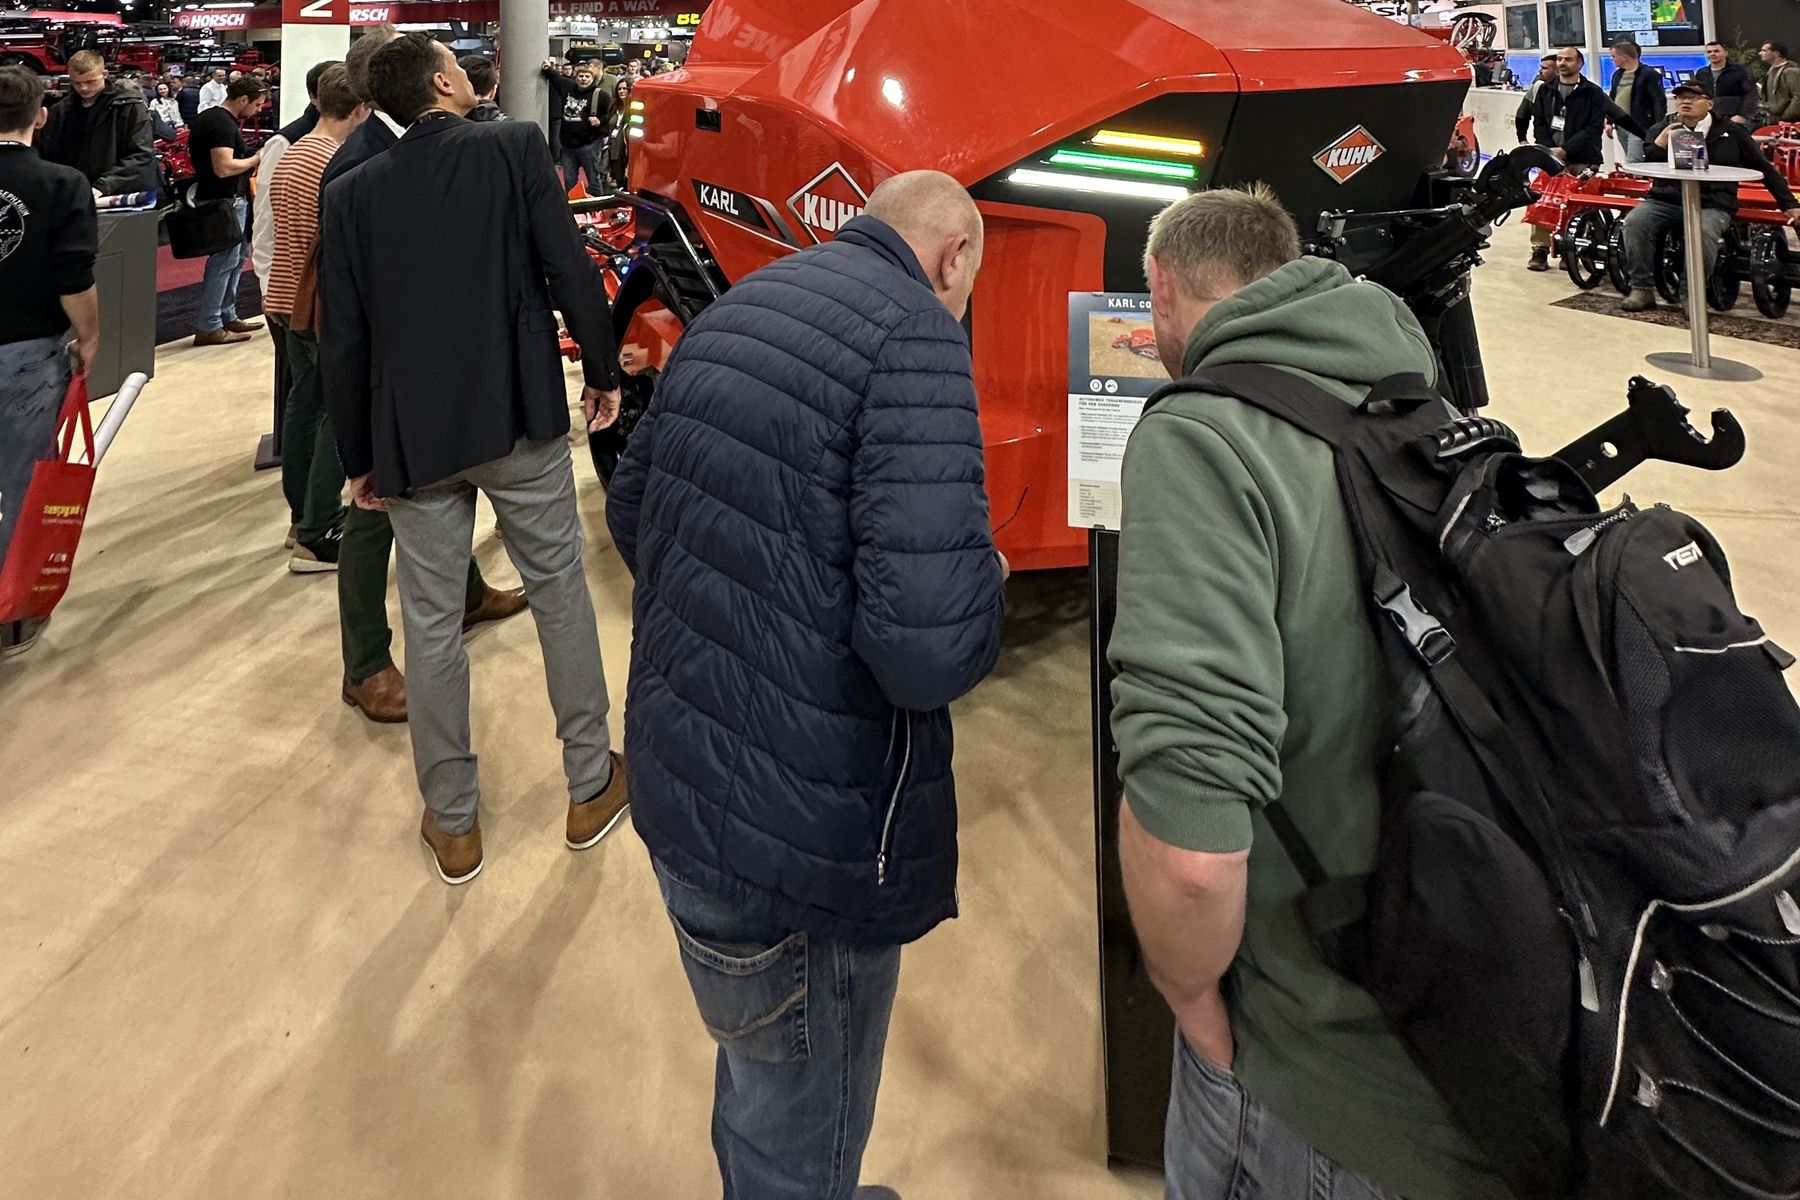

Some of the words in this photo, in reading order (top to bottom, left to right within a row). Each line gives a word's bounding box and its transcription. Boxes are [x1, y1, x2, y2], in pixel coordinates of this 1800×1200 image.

[350, 7, 390, 22] RSCH
[570, 1, 604, 14] FIND
[608, 0, 620, 13] A
[623, 0, 660, 13] WAY.
[190, 13, 246, 28] HORSCH
[1326, 144, 1378, 168] KUHN
[700, 184, 739, 216] KARL
[803, 192, 864, 232] KUH
[1108, 298, 1136, 308] KARL
